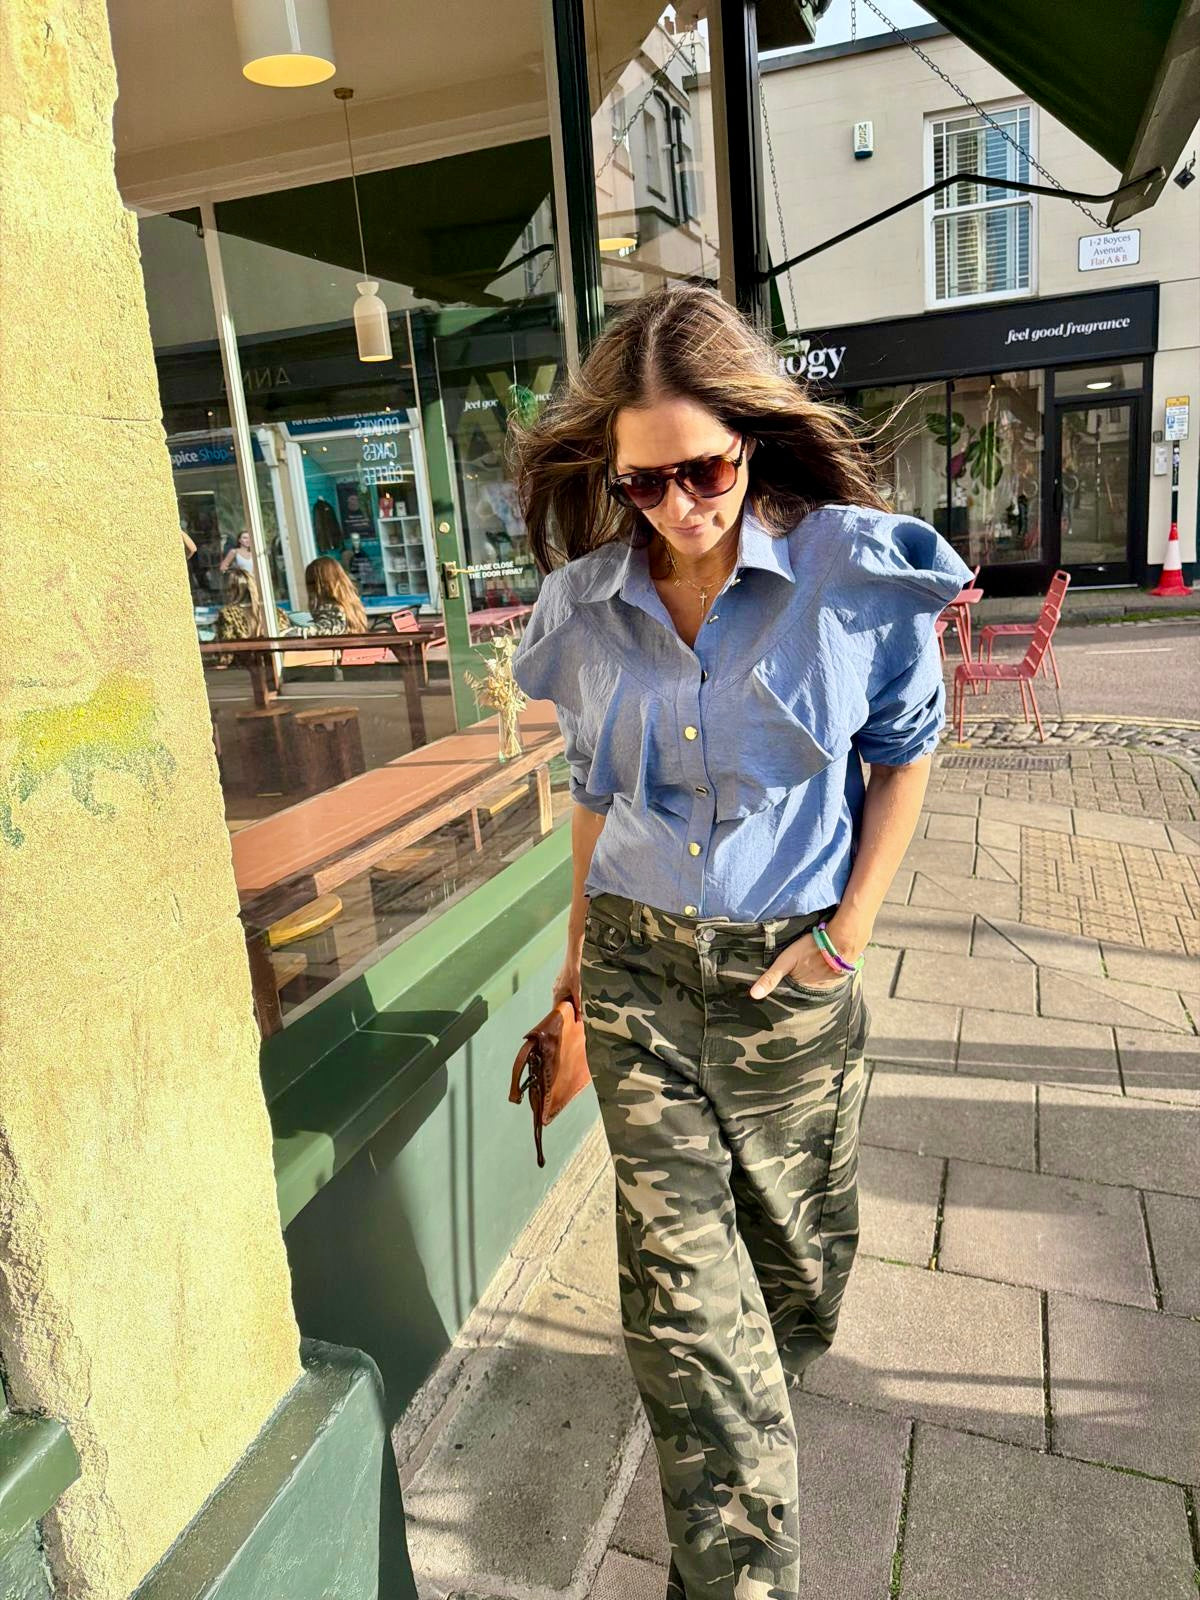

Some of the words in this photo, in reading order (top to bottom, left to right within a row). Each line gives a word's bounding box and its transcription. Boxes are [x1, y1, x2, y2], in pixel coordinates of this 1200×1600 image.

[1103, 234, 1131, 246] Boyces
[1005, 328, 1030, 345] feel
[1031, 323, 1064, 342] good
[1062, 317, 1130, 338] fragrance
[467, 563, 492, 571] PLEASE
[493, 560, 514, 570] CLOSE
[469, 571, 481, 580] THE
[482, 570, 501, 579] DOOR
[502, 567, 523, 577] FIRMLY
